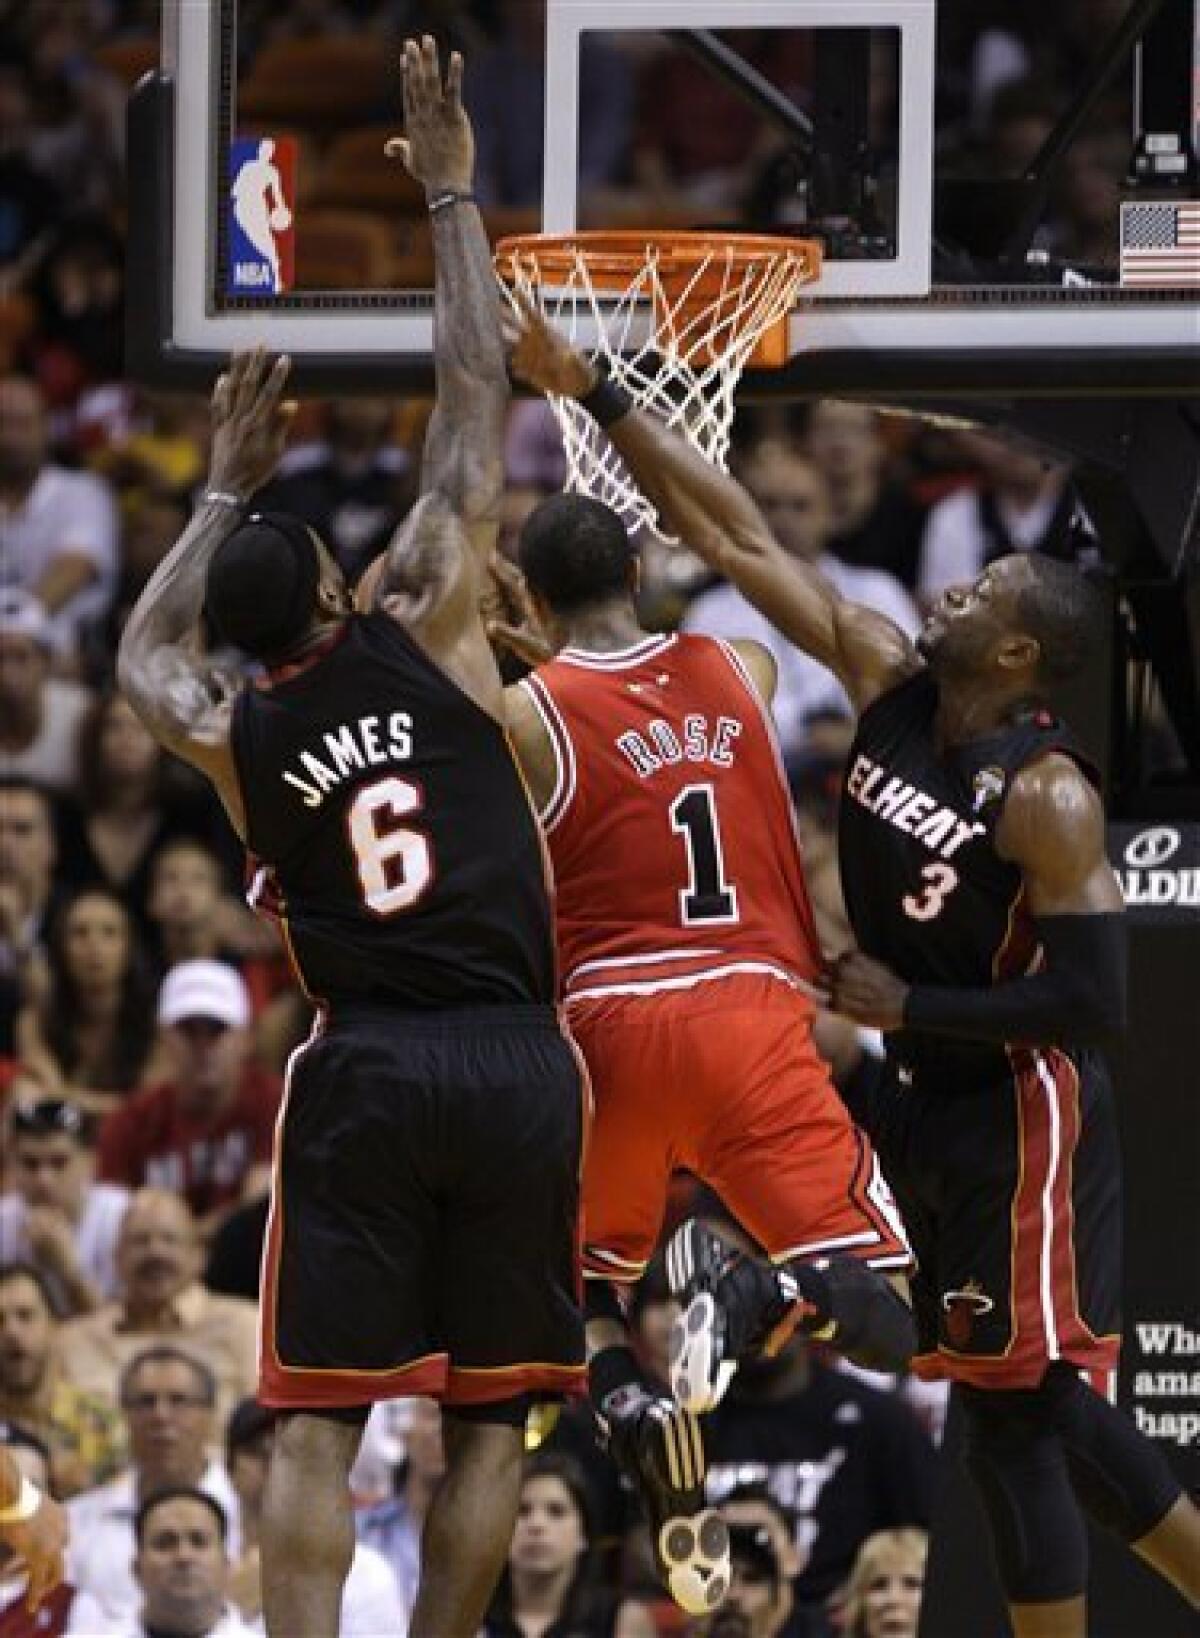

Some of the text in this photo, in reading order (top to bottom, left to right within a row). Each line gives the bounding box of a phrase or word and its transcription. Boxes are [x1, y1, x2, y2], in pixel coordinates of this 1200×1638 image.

[234, 262, 269, 288] NBA
[282, 711, 414, 807] JAMES
[614, 713, 743, 778] ROSE
[347, 775, 433, 914] 6
[668, 783, 740, 928] 1
[902, 861, 960, 921] 3
[1113, 868, 1200, 905] LDI
[1135, 1321, 1200, 1355] Wh
[1133, 1405, 1200, 1447] hap
